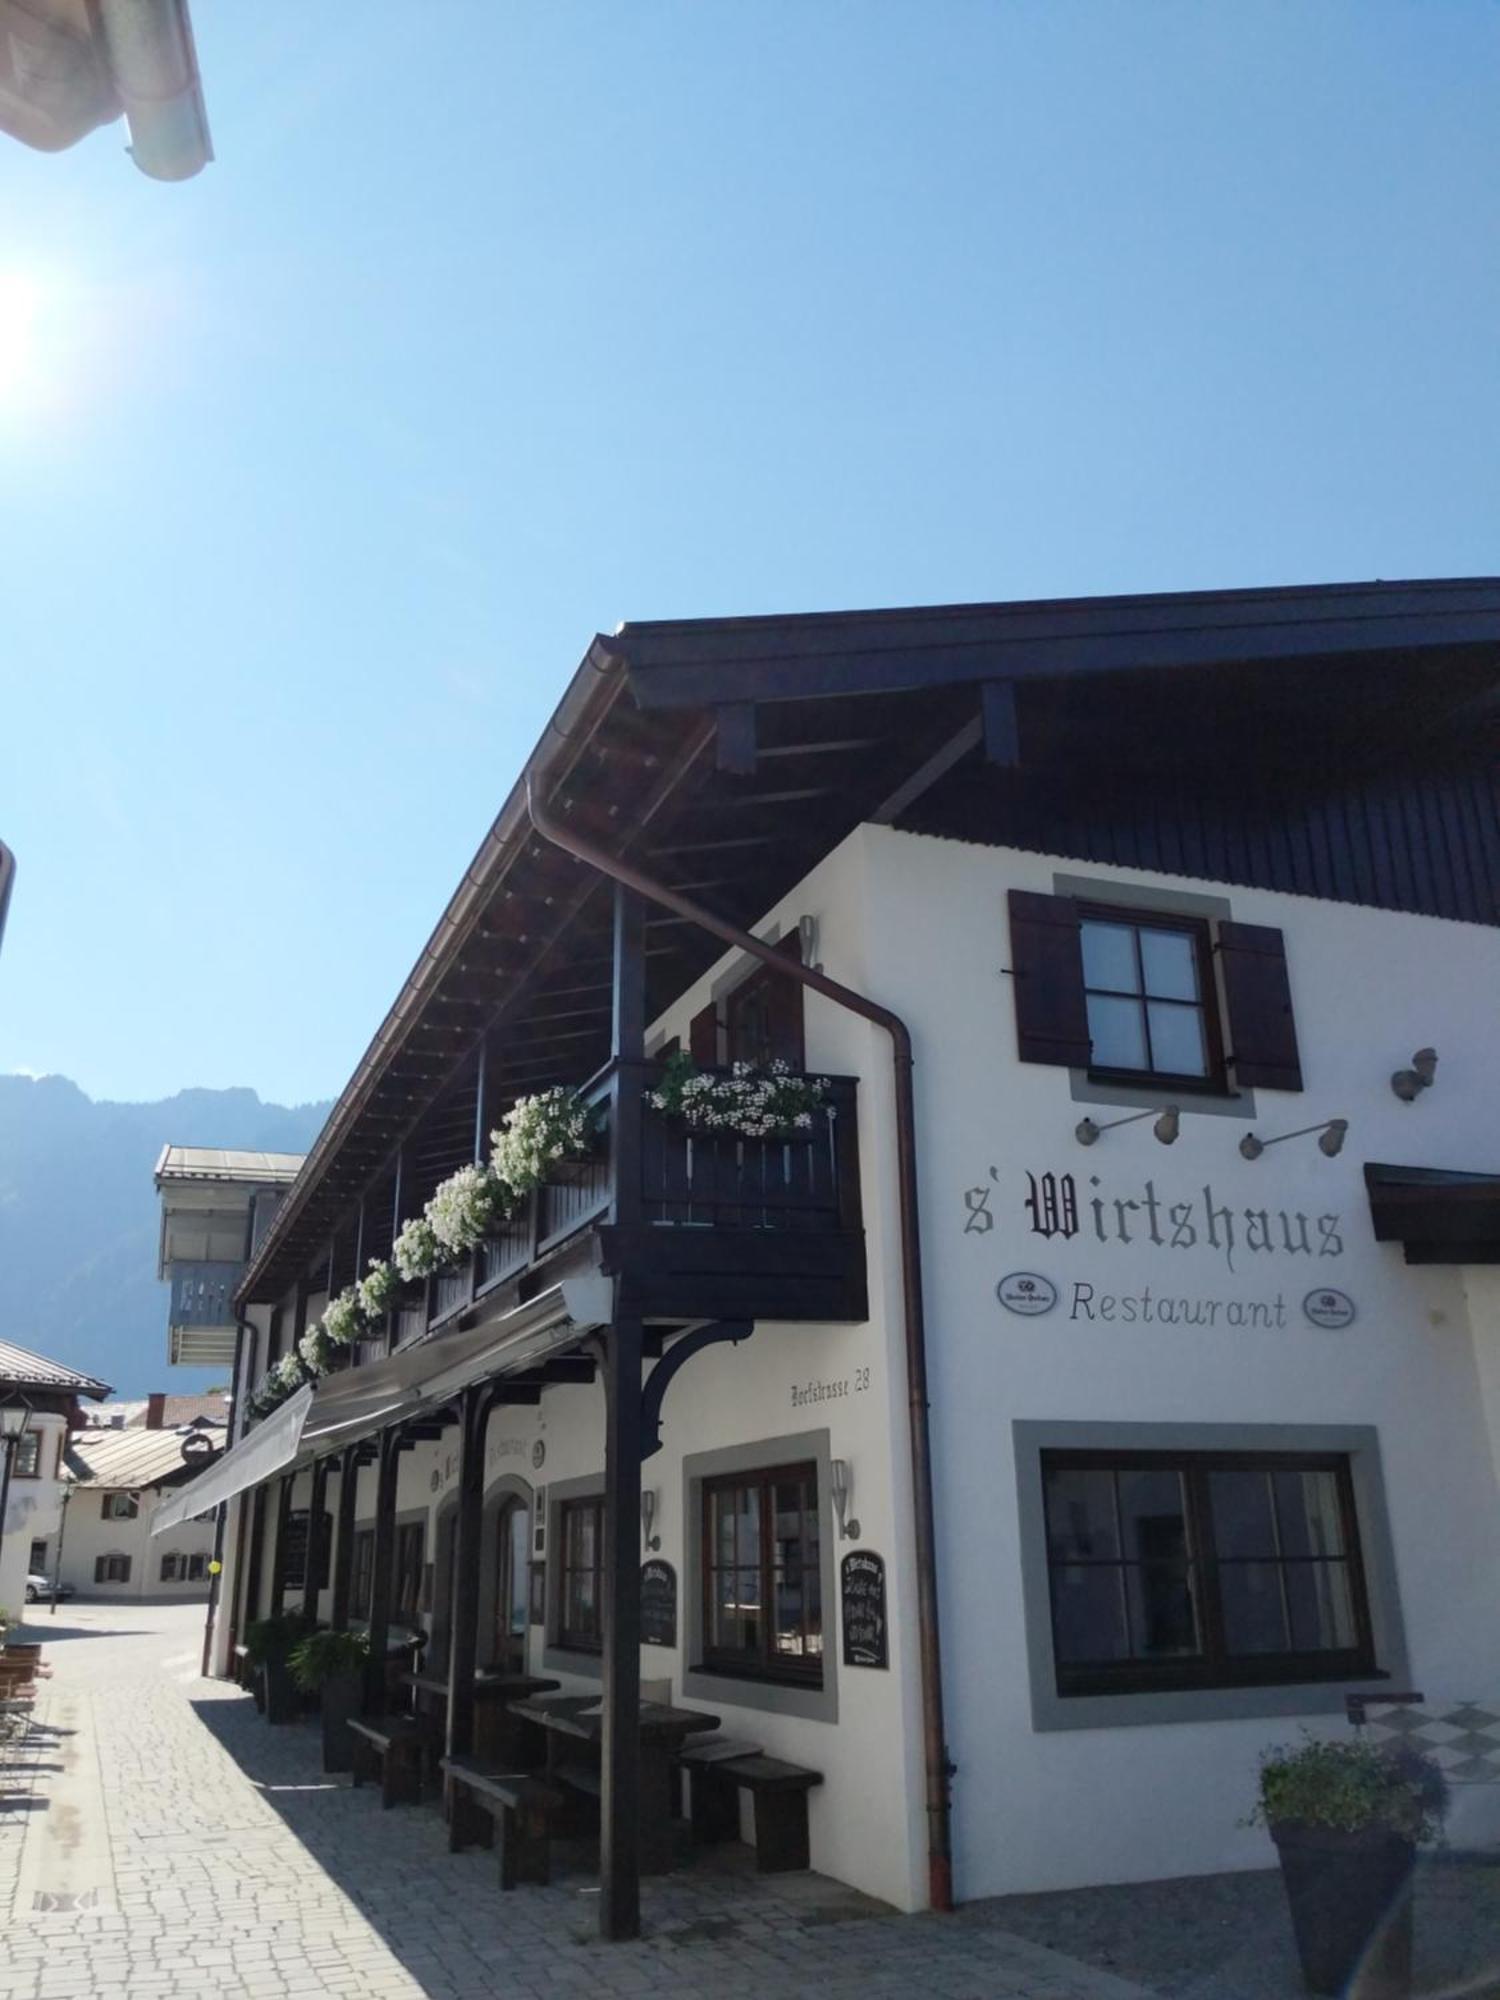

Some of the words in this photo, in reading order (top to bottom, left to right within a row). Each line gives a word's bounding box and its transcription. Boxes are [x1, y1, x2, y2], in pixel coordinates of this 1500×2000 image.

[1025, 1169, 1345, 1273] Wirtshaus
[1069, 1281, 1288, 1329] Restaurant
[855, 1367, 870, 1392] 28
